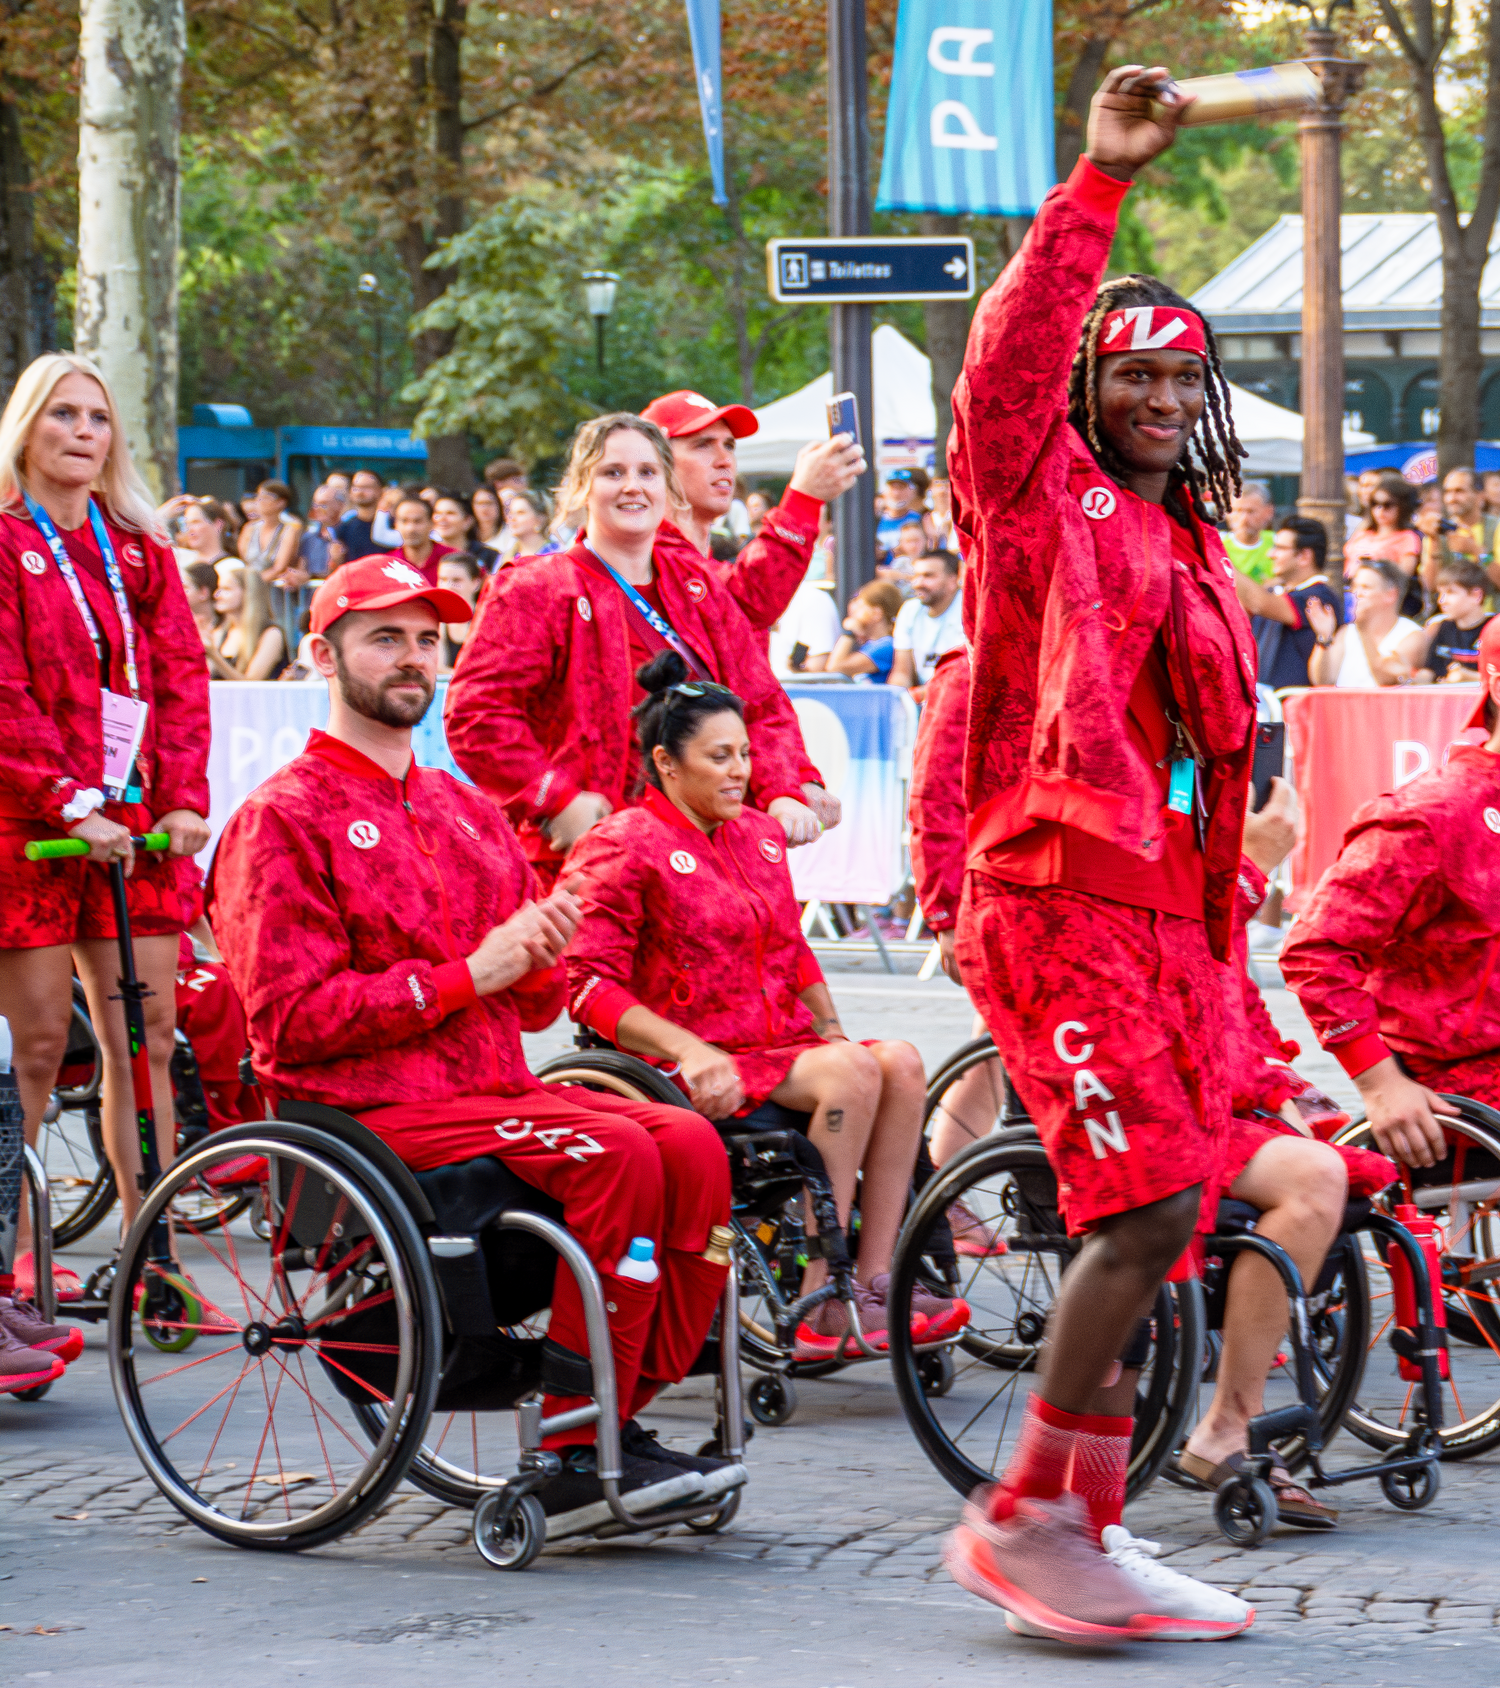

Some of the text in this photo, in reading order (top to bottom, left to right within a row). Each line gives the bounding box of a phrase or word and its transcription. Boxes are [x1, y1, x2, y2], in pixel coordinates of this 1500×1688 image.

[927, 26, 998, 151] PA
[829, 260, 892, 280] Toilettes
[407, 973, 426, 1010] CANADA
[1323, 1019, 1359, 1039] CANADA
[1053, 1020, 1131, 1160] CAN
[494, 1118, 605, 1162] CAN
